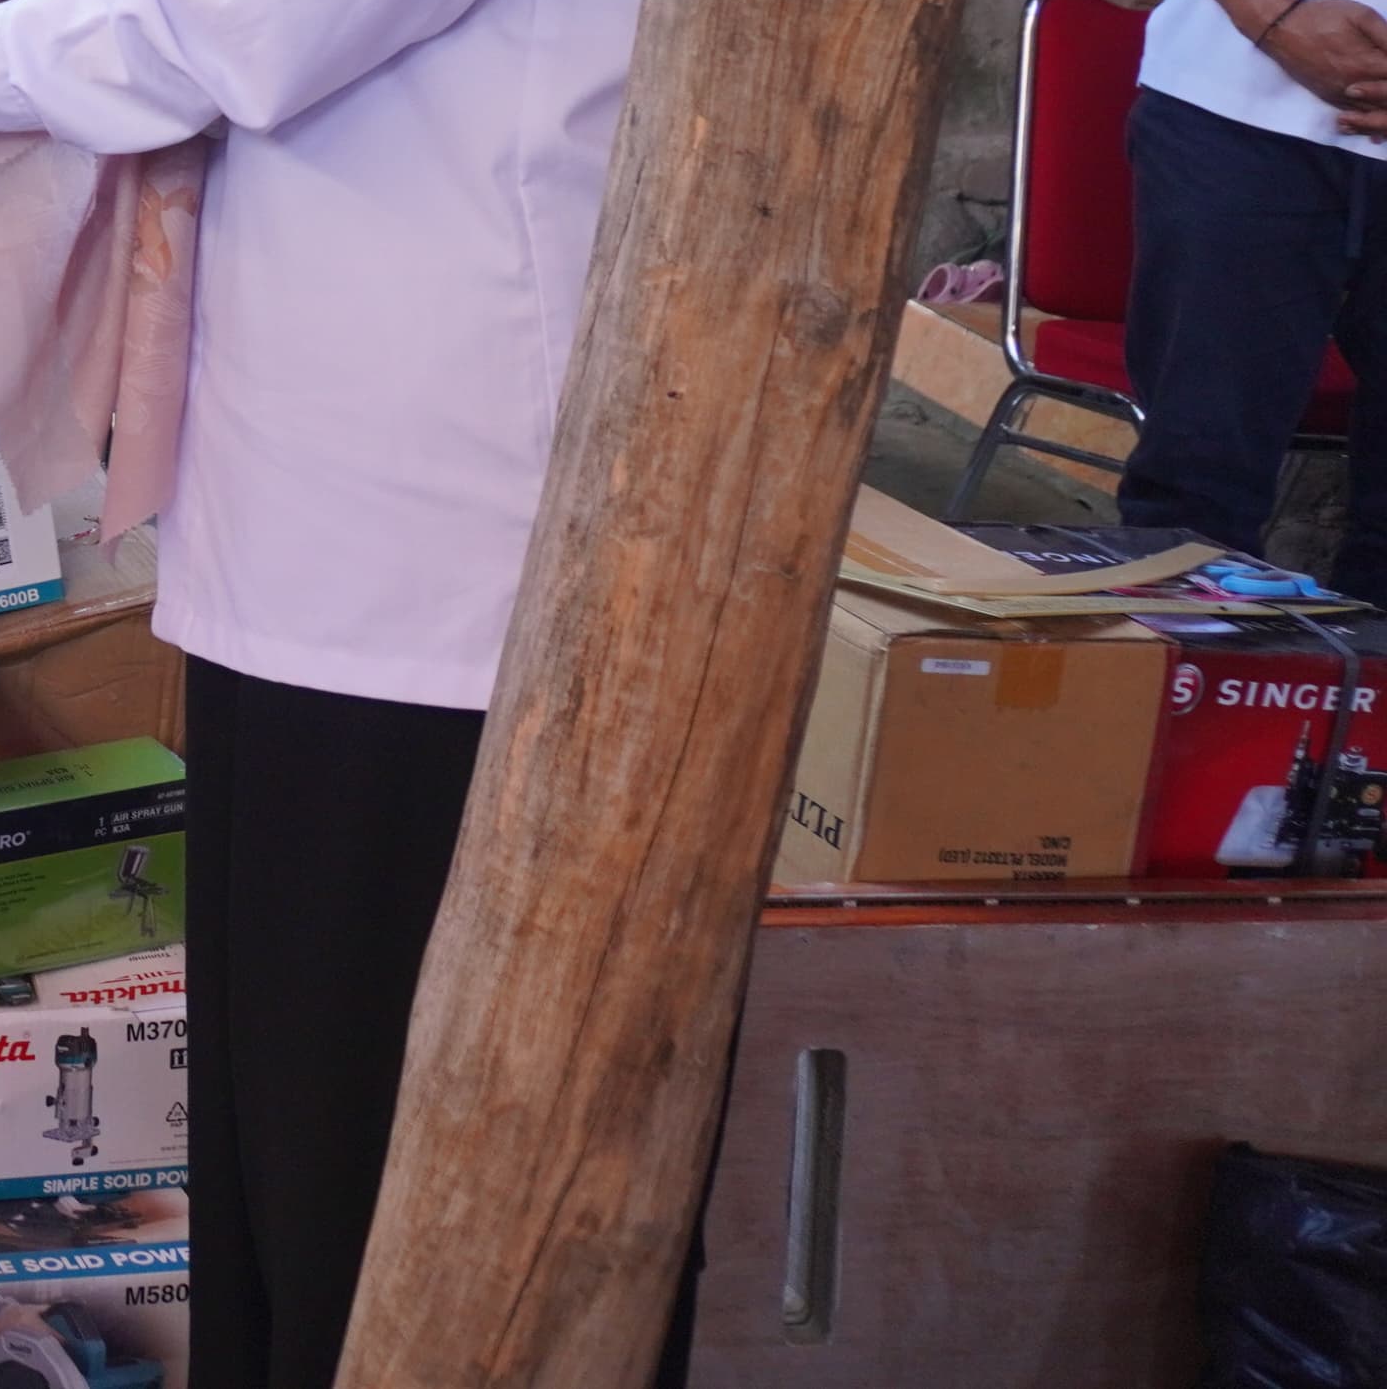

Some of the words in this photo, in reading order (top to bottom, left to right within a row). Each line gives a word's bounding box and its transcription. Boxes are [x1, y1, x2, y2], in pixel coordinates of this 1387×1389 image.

[1216, 678, 1377, 713] SINGER
[130, 806, 161, 821] SPRAY
[163, 802, 184, 814] GUN
[42, 1176, 99, 1194] SIMPLE
[102, 1173, 152, 1189] SOLID
[21, 1254, 105, 1272] SOLID
